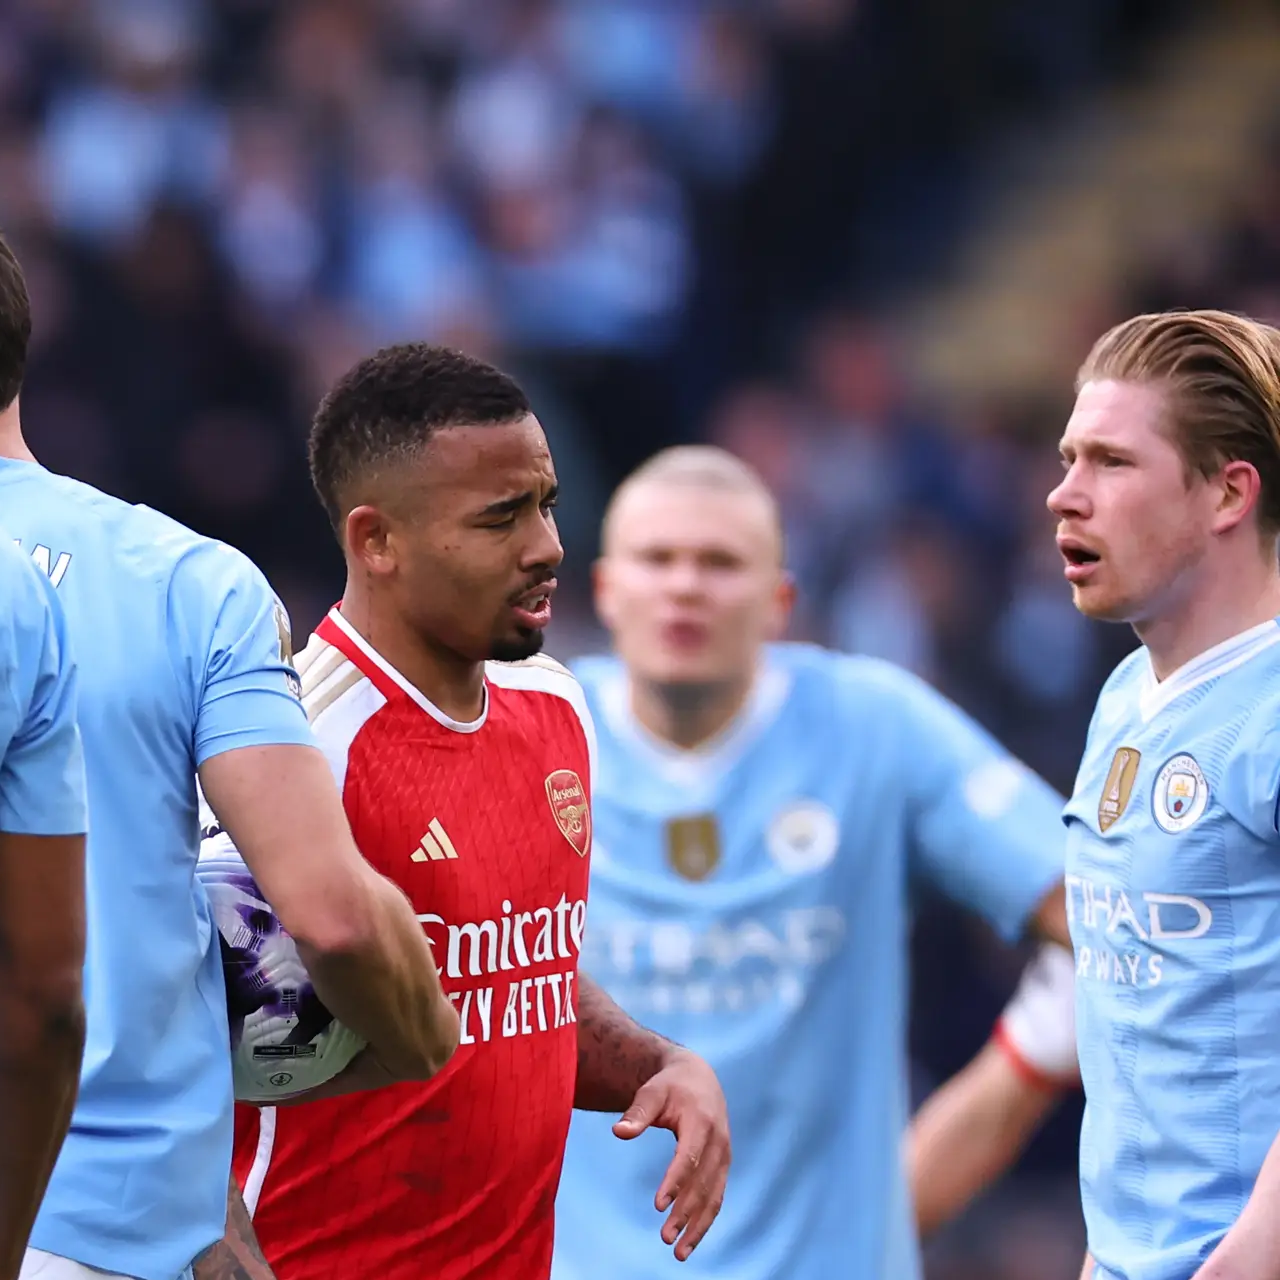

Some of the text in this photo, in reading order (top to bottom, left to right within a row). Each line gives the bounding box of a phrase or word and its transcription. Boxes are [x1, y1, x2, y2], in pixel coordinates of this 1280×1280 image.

[552, 786, 581, 803] Arsenal
[414, 891, 587, 979] mirate
[1064, 872, 1213, 940] TIHAD
[1076, 945, 1164, 987] RWAYS
[502, 970, 578, 1039] BETTR
